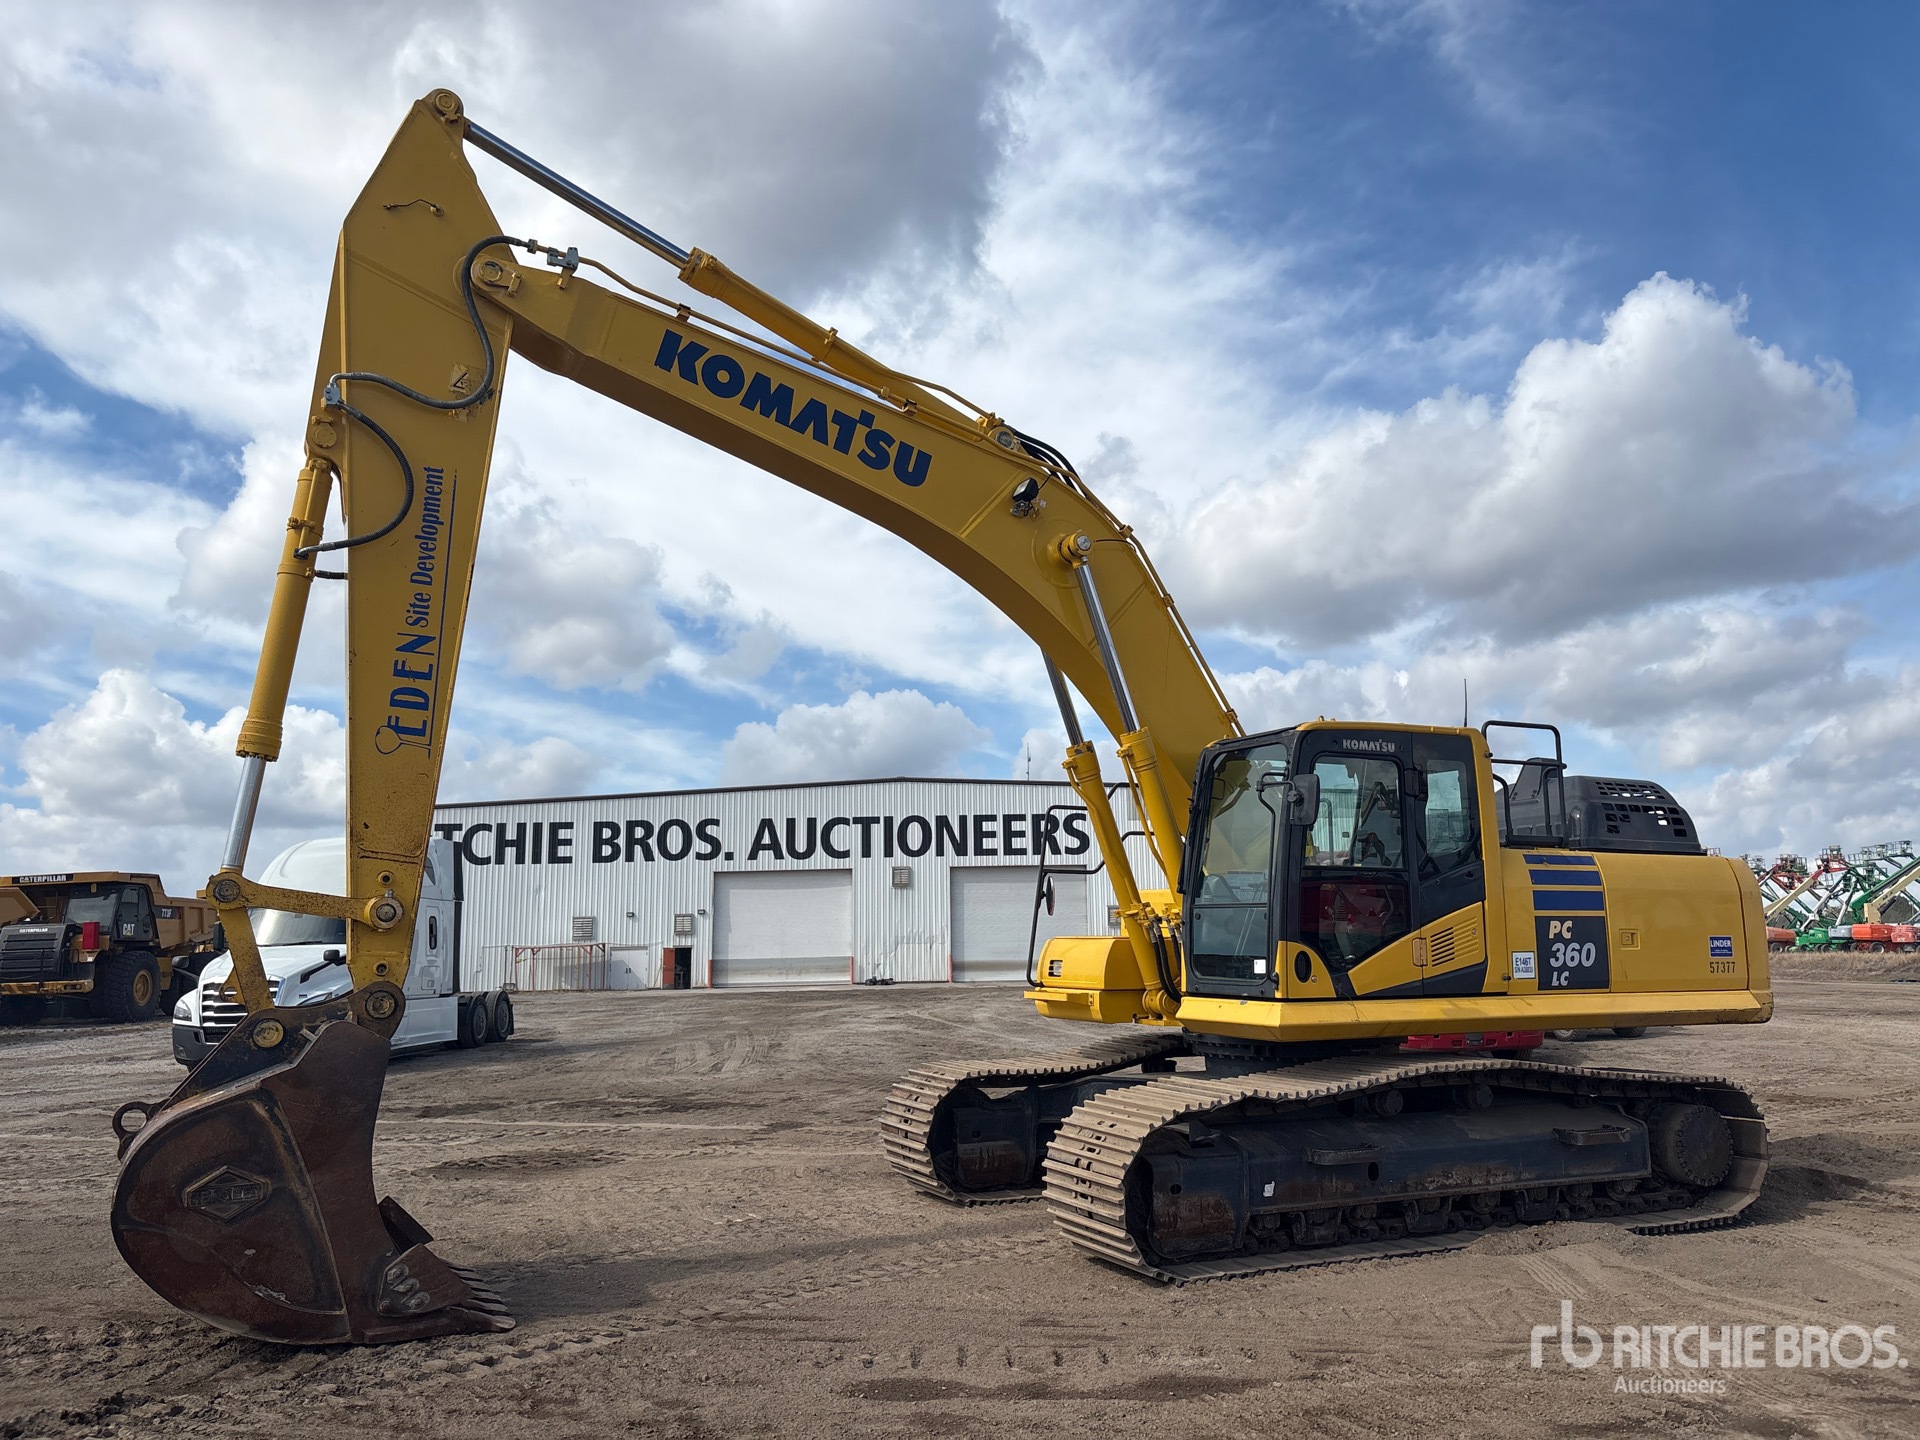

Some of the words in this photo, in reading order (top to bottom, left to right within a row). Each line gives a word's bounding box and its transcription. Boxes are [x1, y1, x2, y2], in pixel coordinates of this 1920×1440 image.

[654, 328, 932, 487] KOMATSU
[410, 466, 444, 586] Development
[405, 592, 432, 628] Site
[387, 633, 437, 737] EDEN
[1343, 739, 1395, 752] KOMATSU
[593, 818, 734, 863] BROS.
[747, 813, 1090, 860] AUCTIONEERS
[19, 875, 67, 883] CATERPILLAR
[122, 923, 135, 936] CAT
[1548, 920, 1573, 939] PC
[1710, 940, 1732, 948] LINDER
[1549, 942, 1596, 968] 360
[1709, 961, 1736, 974] 57377
[1551, 971, 1570, 986] LC
